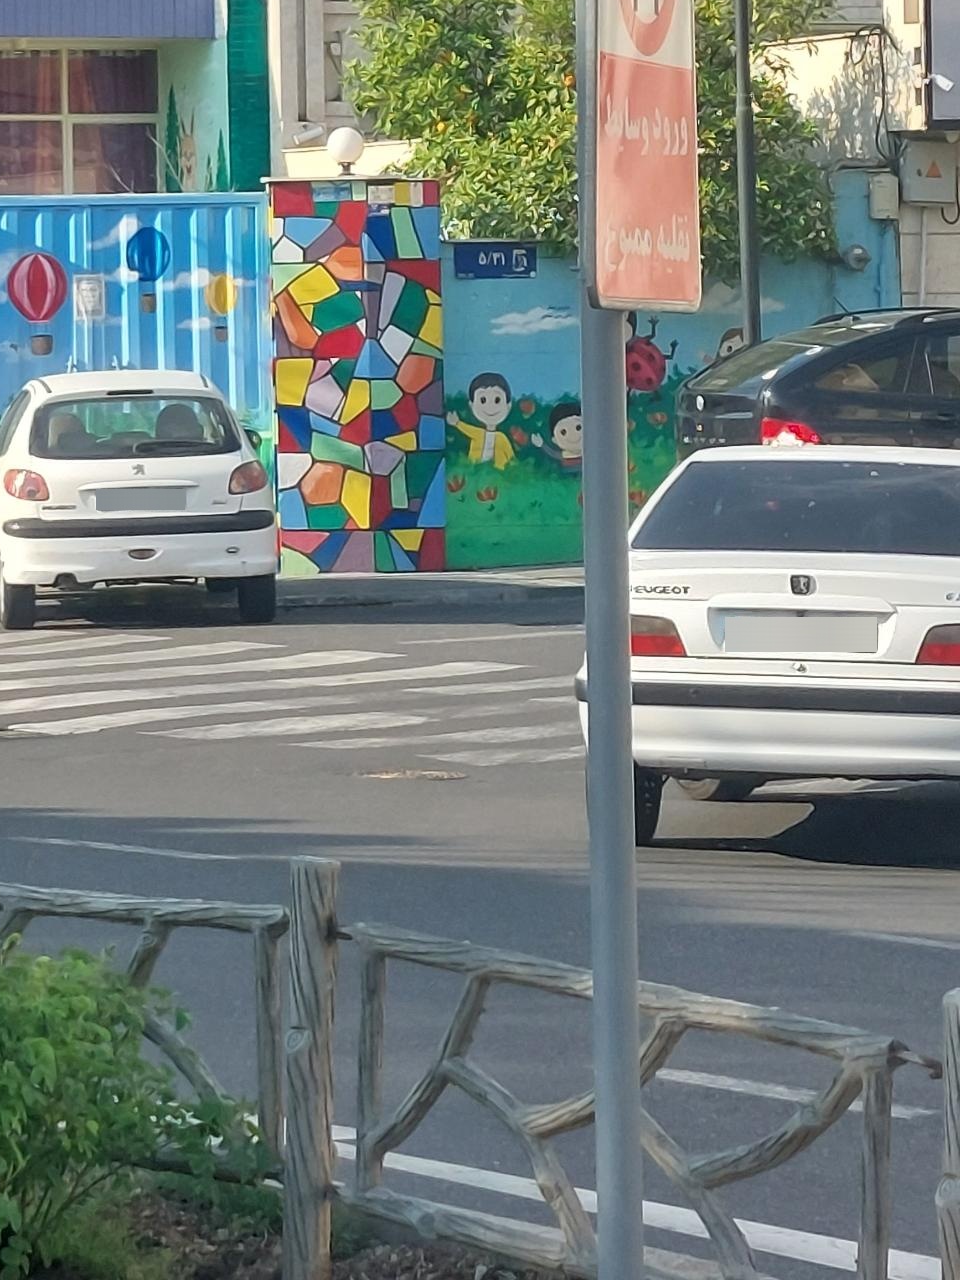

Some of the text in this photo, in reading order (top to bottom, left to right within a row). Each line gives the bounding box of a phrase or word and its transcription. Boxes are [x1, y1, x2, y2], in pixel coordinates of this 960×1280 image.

[652, 107, 688, 156] ورود
[604, 214, 689, 273] نقلیه ممنوع
[631, 585, 691, 595] EUGEOT
